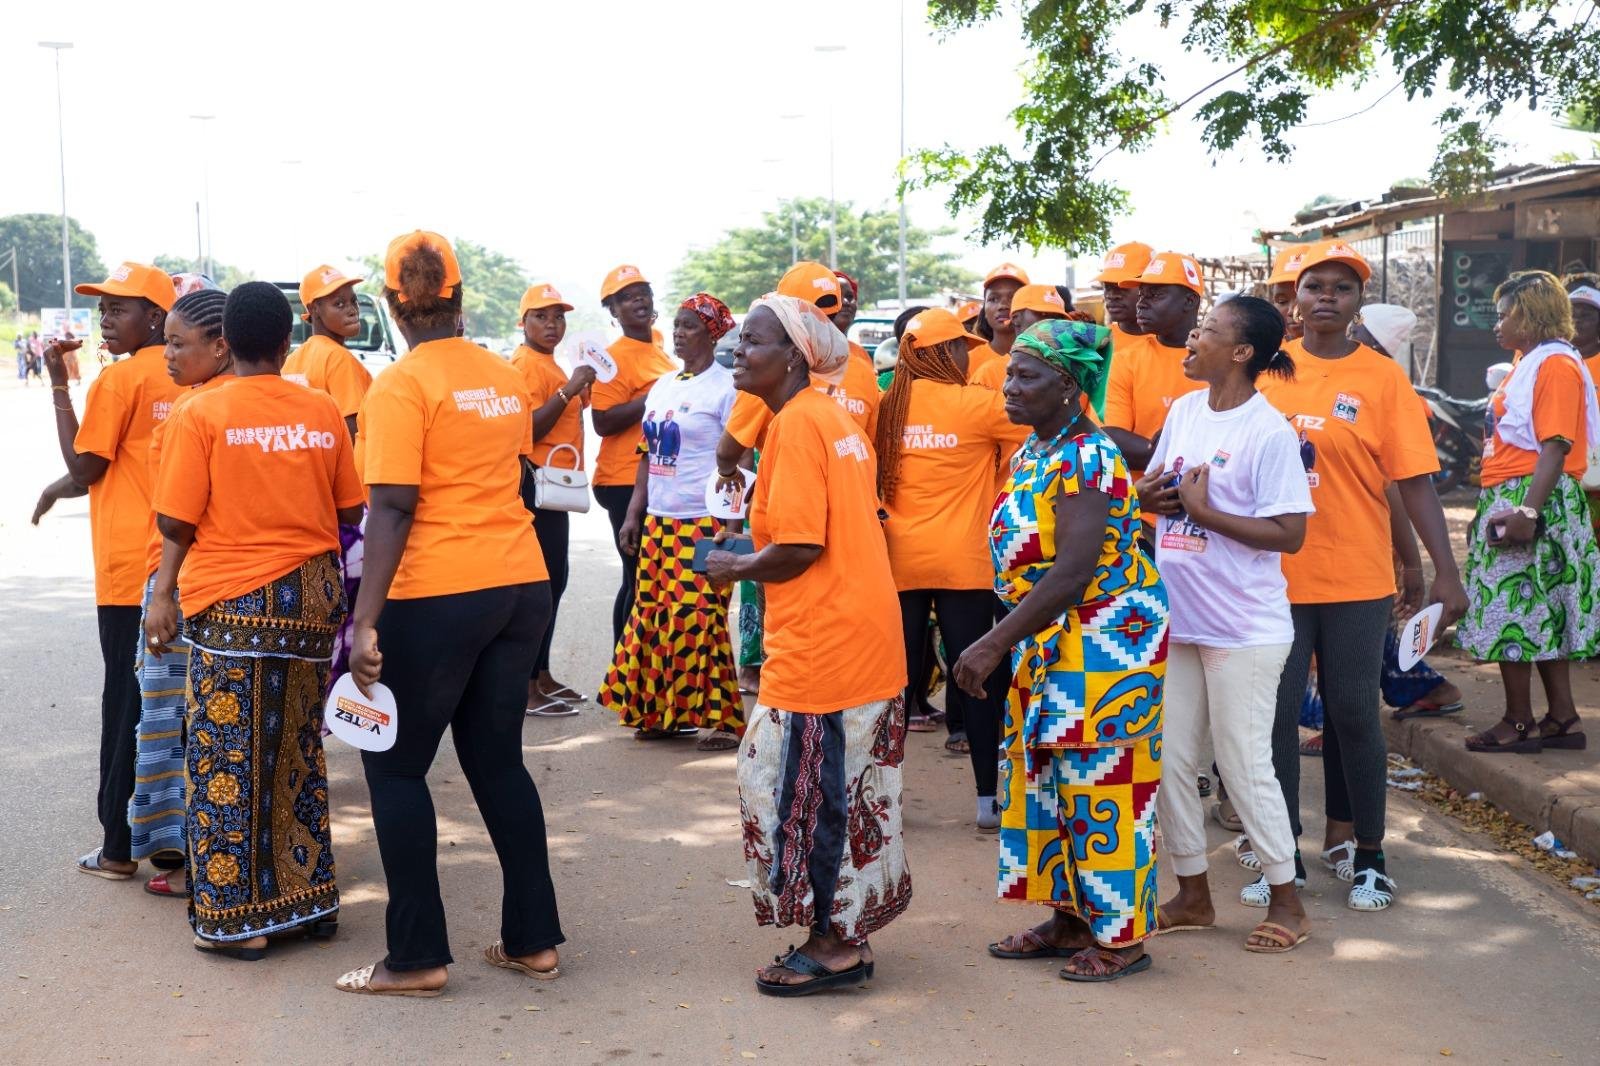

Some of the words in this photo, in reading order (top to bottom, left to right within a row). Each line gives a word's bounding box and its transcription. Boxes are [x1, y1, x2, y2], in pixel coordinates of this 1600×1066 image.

[474, 395, 522, 420] YAKRO
[225, 423, 306, 439] ENSEMBLE
[227, 436, 256, 446] POUR
[255, 430, 336, 453] YAKRO
[903, 433, 958, 449] YAKRO
[335, 707, 381, 735] VOTEZ
